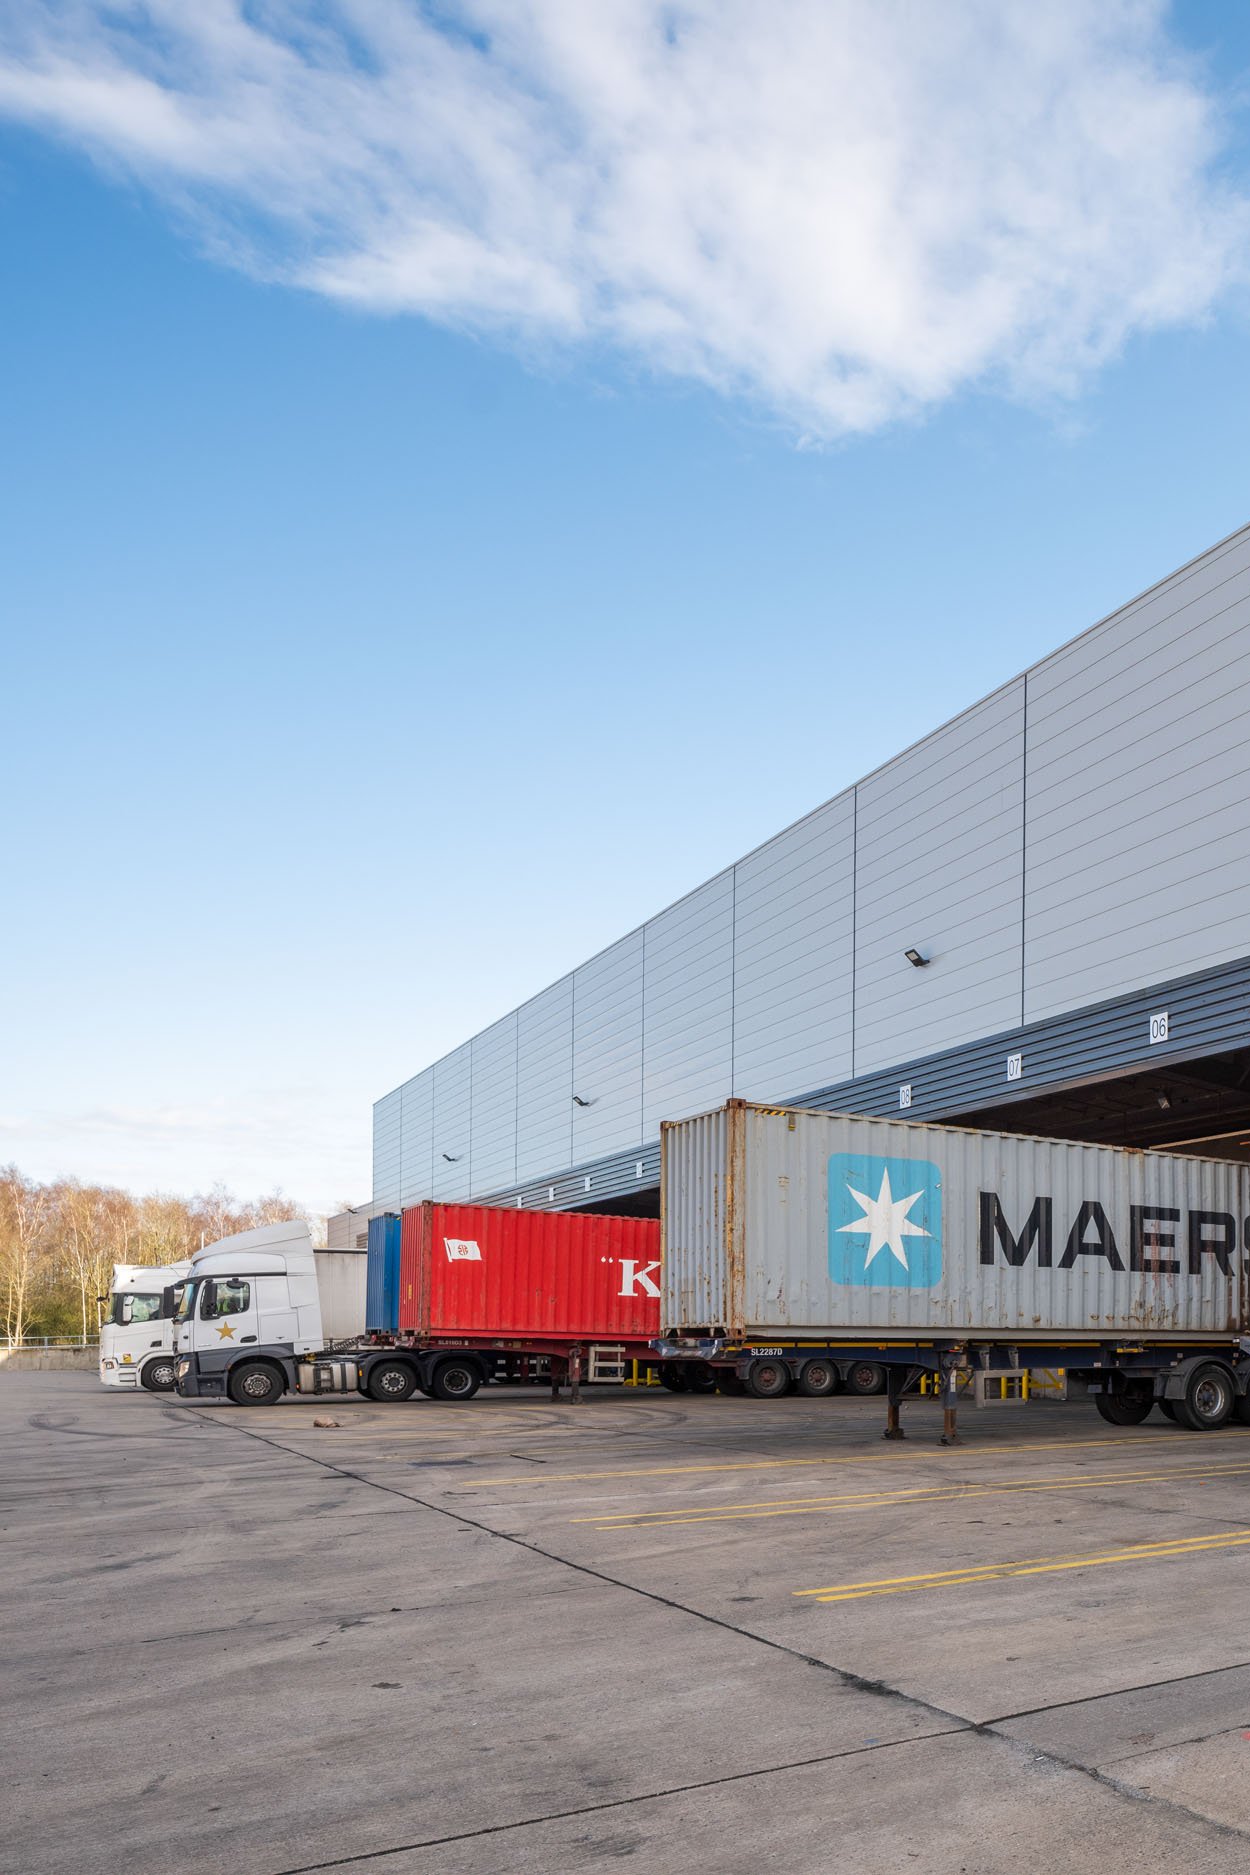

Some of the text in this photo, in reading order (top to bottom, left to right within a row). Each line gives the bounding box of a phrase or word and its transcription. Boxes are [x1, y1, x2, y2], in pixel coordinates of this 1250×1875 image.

[1152, 1018, 1166, 1039] 06
[1009, 1058, 1020, 1077] 07
[901, 1089, 910, 1105] 08
[751, 1348, 783, 1356] SL2287D
